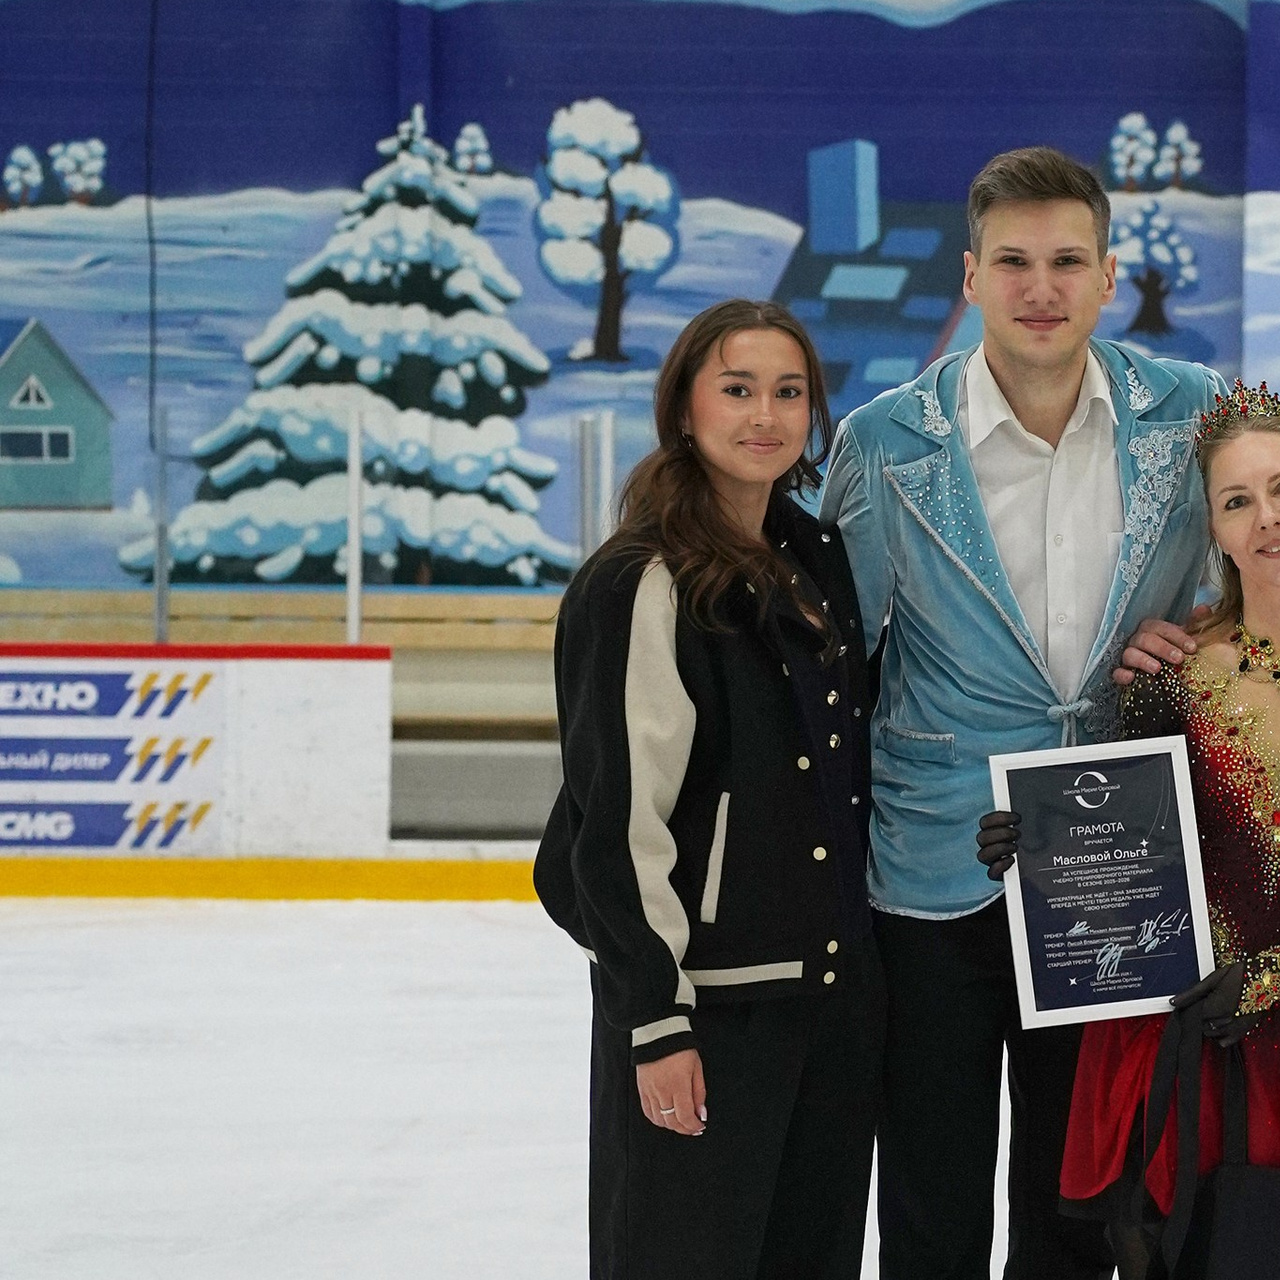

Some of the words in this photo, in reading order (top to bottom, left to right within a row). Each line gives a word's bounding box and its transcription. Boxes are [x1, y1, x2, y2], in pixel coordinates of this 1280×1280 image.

[1098, 784, 1120, 792] Орловой
[1069, 822, 1125, 837] ГРАМОТА
[1084, 838, 1113, 846] ВРУЧАЕТСЯ
[1053, 850, 1111, 866] Масловой
[1113, 849, 1148, 860] Ольге
[1070, 868, 1099, 876] УСПЕШНОЕ
[1099, 864, 1139, 873] ПРОХОЖДЕНИЕ
[1122, 868, 1154, 876] МАТЕРИАЛА
[1047, 894, 1085, 903] ИМПЕРАТРИЦА
[1072, 958, 1093, 966] ТРЕНЕР:
